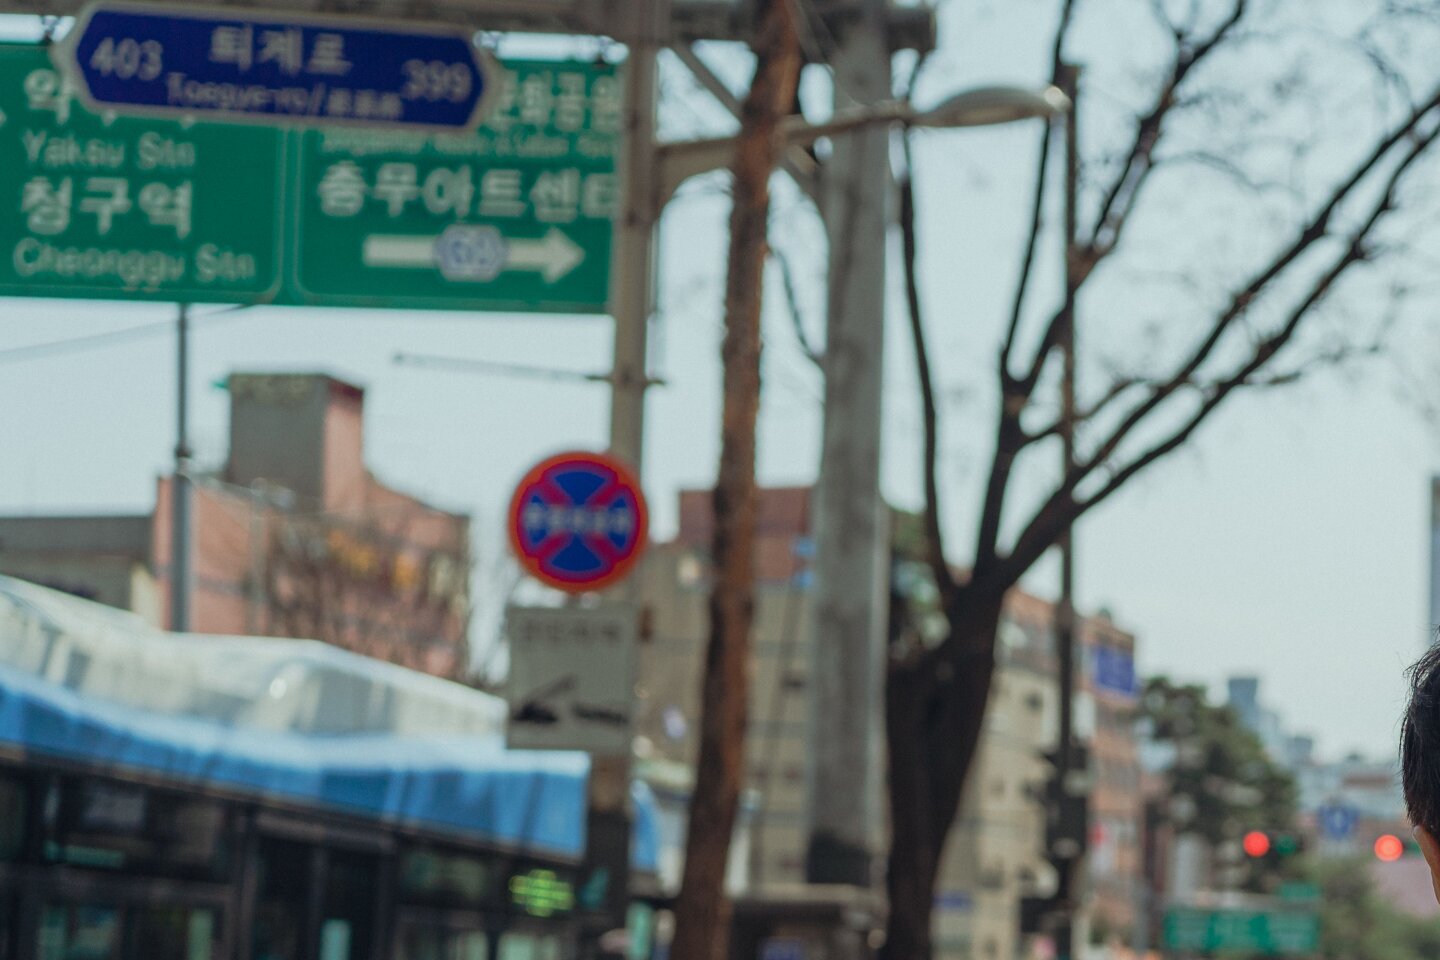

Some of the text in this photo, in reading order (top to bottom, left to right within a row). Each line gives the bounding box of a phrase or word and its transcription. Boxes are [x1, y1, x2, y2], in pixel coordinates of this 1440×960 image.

[89, 36, 164, 81] 403
[208, 25, 354, 75] 퇴계로
[401, 58, 473, 102] 399
[21, 128, 126, 169] Yaksu
[20, 176, 194, 240] 청구역
